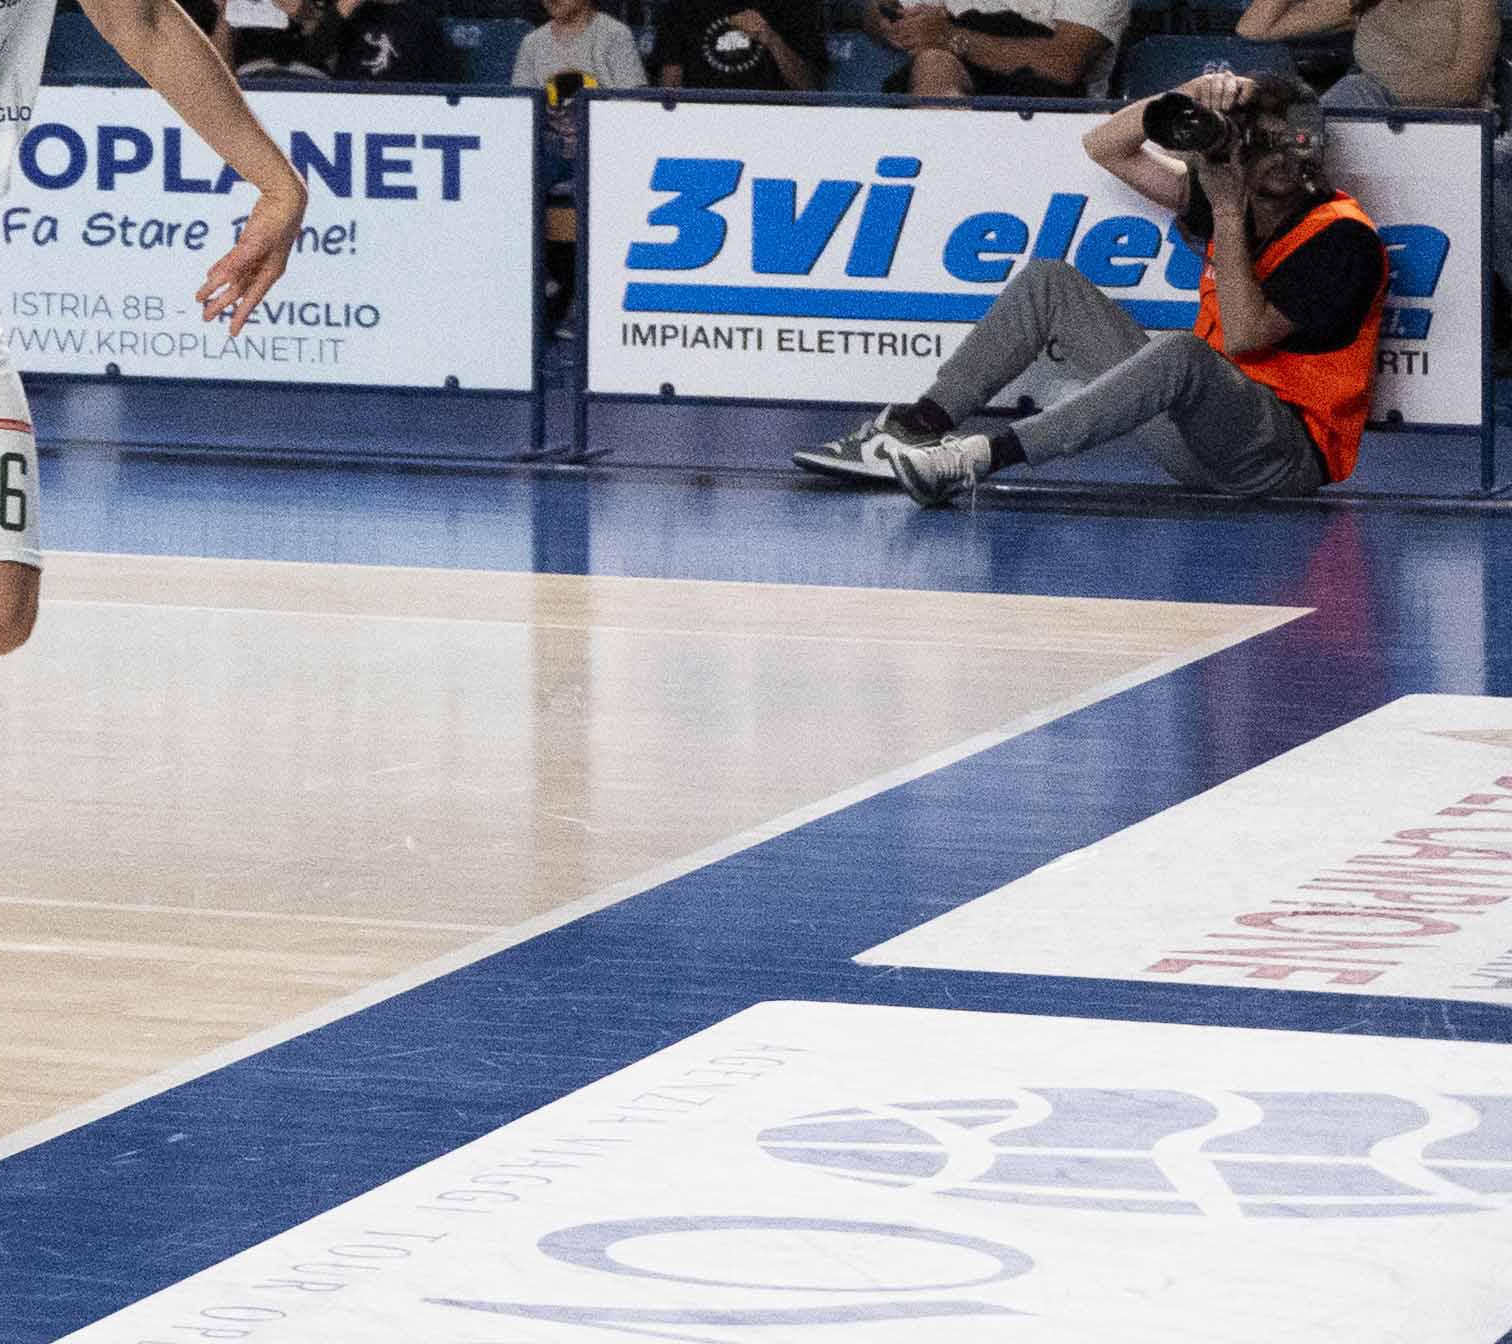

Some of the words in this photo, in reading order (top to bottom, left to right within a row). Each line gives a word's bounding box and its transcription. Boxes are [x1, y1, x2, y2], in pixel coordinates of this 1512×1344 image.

[2, 206, 59, 248] Fa
[81, 210, 210, 253] Stare
[623, 155, 922, 279] 3vi
[10, 291, 114, 320] ISTRIA
[122, 295, 165, 323] 8B
[621, 321, 764, 353] IMPIANTI
[776, 328, 943, 358] ELETTRICI
